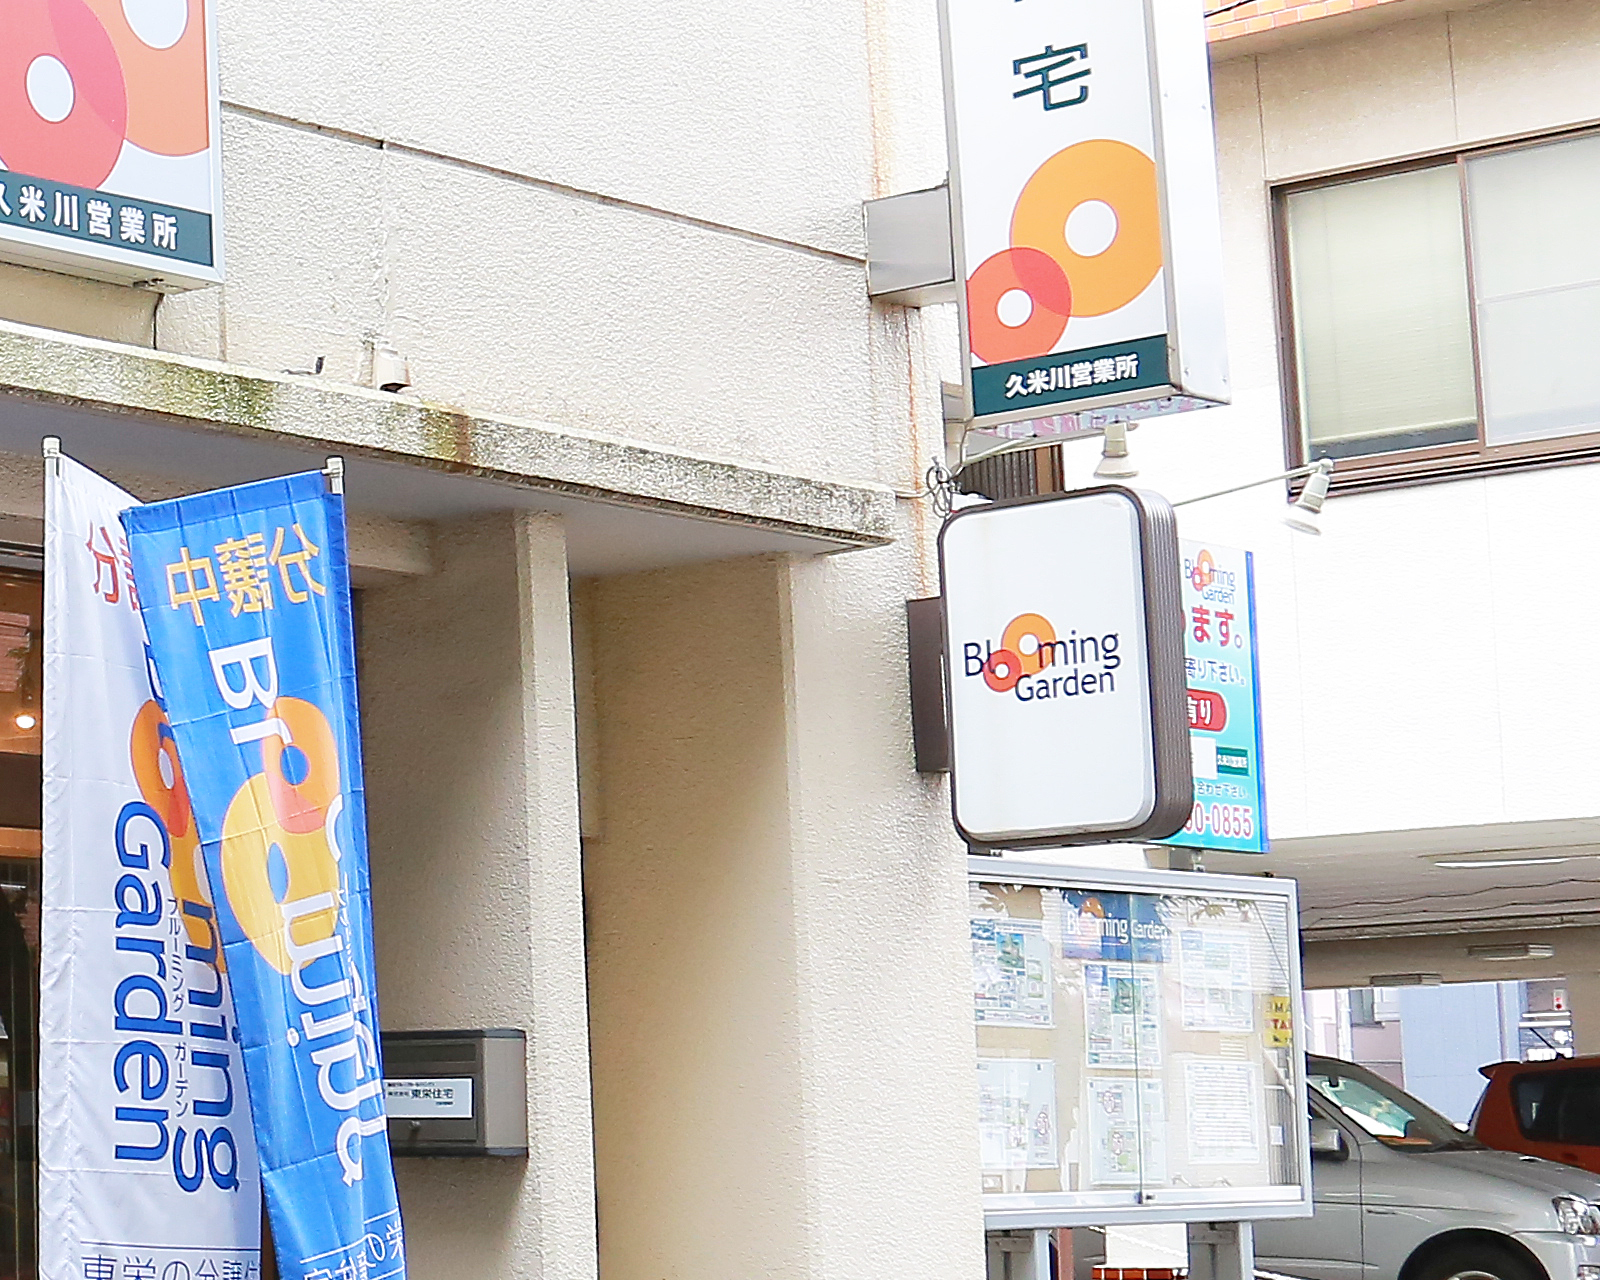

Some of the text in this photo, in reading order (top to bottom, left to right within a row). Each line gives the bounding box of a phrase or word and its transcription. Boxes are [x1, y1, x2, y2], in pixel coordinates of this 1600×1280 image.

[1005, 353, 1140, 400] 久米川営業所
[1202, 587, 1235, 605] Garden
[1181, 604, 1243, 649] ます。
[963, 612, 1121, 692] Blooming
[1014, 669, 1116, 701] Garden
[112, 799, 185, 1164] Garden
[174, 1042, 189, 1119] ガーデン
[411, 1088, 454, 1099] 東栄住宅
